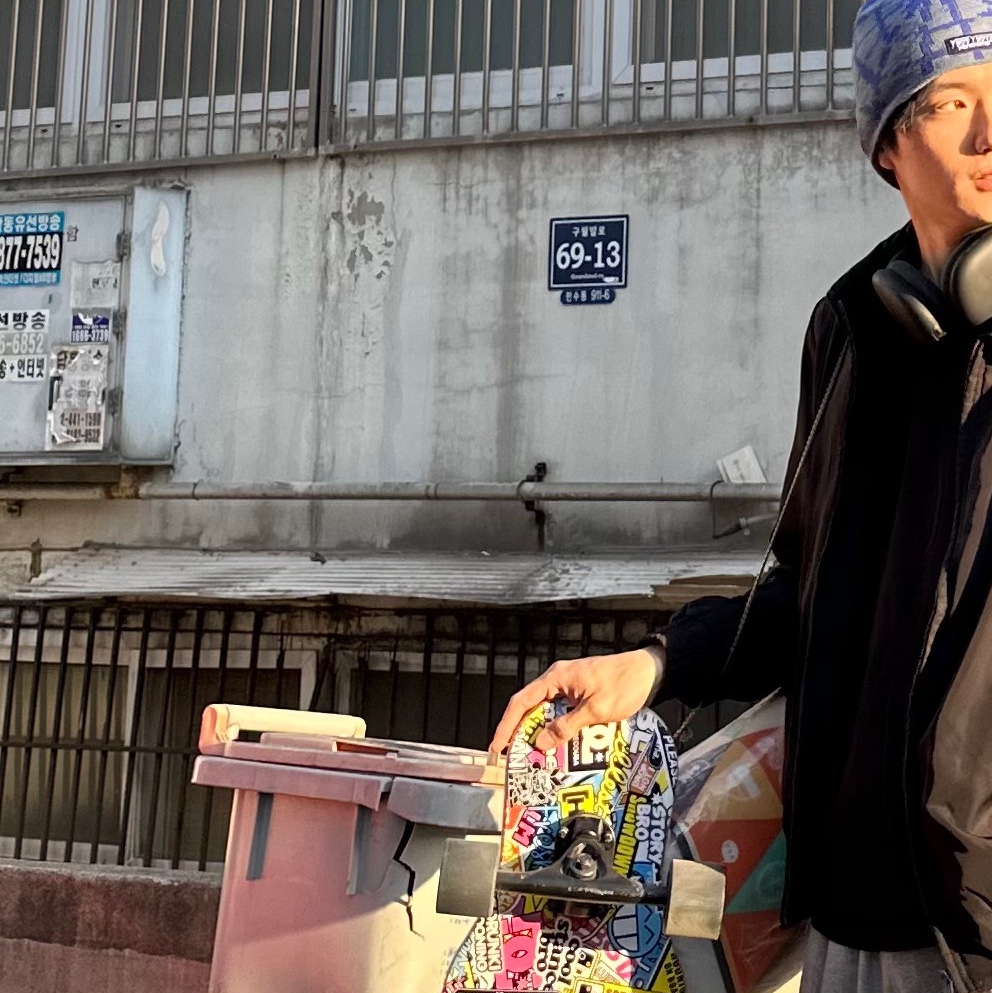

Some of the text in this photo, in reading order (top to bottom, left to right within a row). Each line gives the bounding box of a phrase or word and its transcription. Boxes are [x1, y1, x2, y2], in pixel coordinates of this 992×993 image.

[556, 241, 620, 269] 69-13
[635, 804, 652, 841] BRO
[647, 805, 668, 865] STORY
[536, 932, 548, 972] bro
[558, 938, 580, 984] cool
